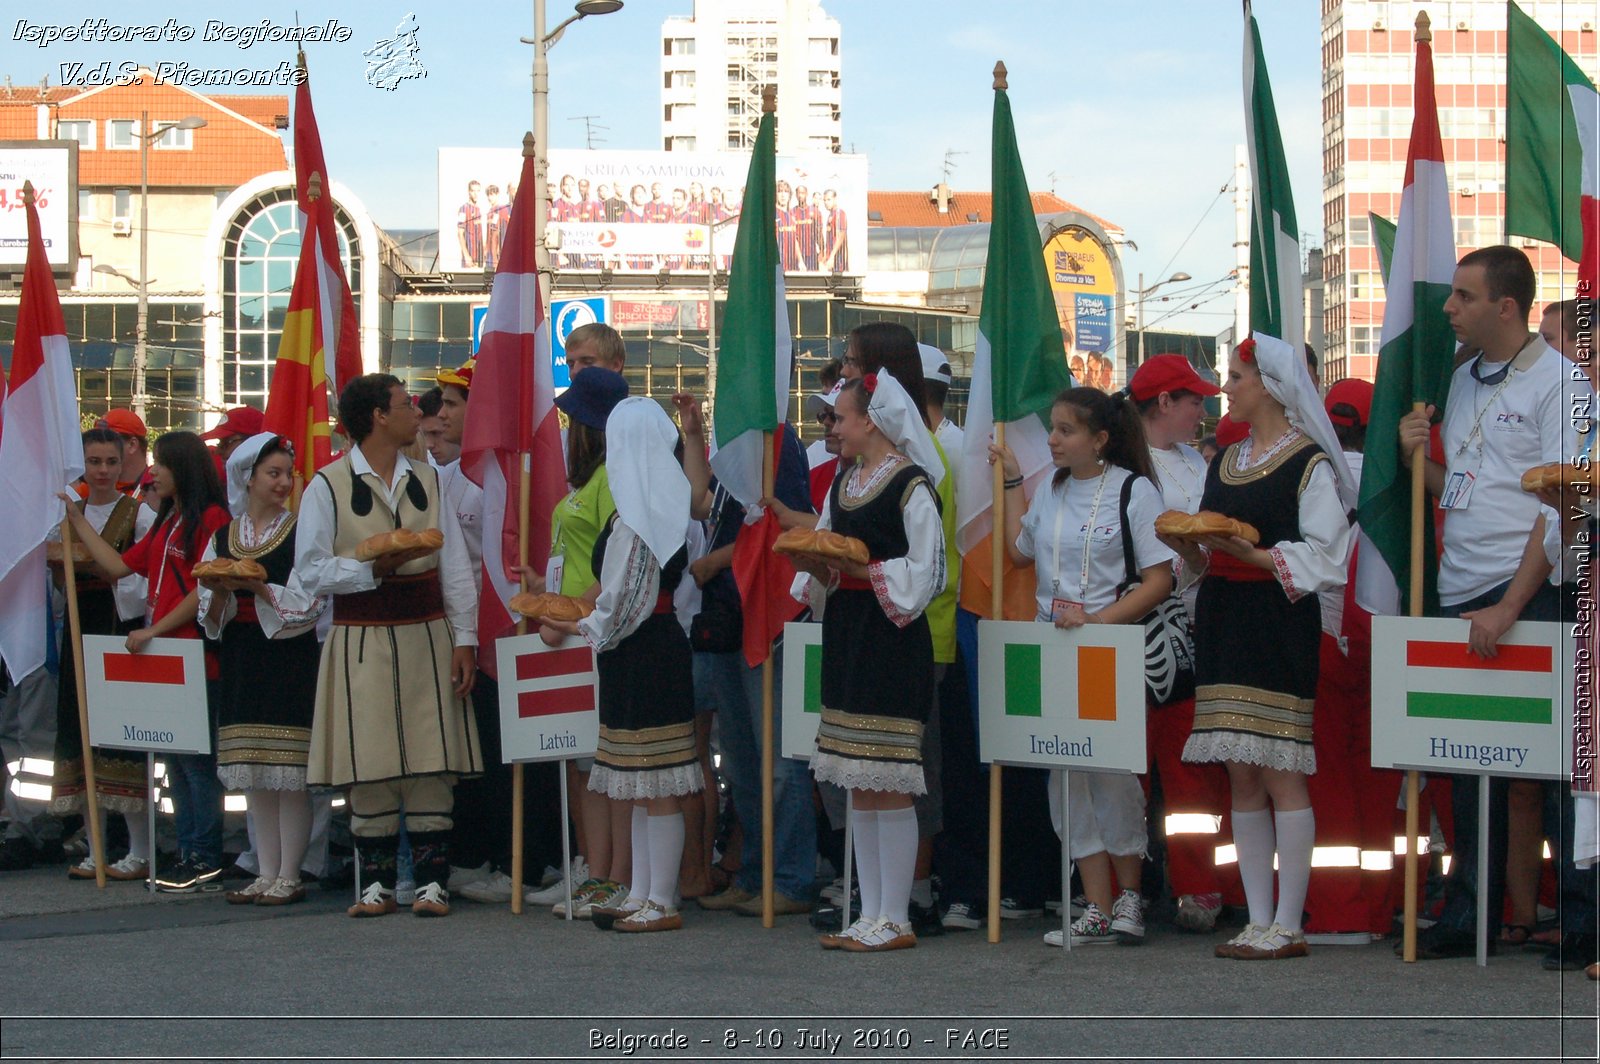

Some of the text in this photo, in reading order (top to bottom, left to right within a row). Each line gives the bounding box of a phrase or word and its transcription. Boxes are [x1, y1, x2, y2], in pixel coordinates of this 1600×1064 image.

[584, 164, 631, 177] KRILA
[562, 229, 595, 238] RKISH
[562, 239, 595, 247] LINES
[1080, 524, 1113, 535] FCE
[123, 725, 174, 744] Monaco
[539, 730, 577, 751] Latvia
[1029, 734, 1094, 757] Ireland
[1429, 737, 1529, 768] Hungary
